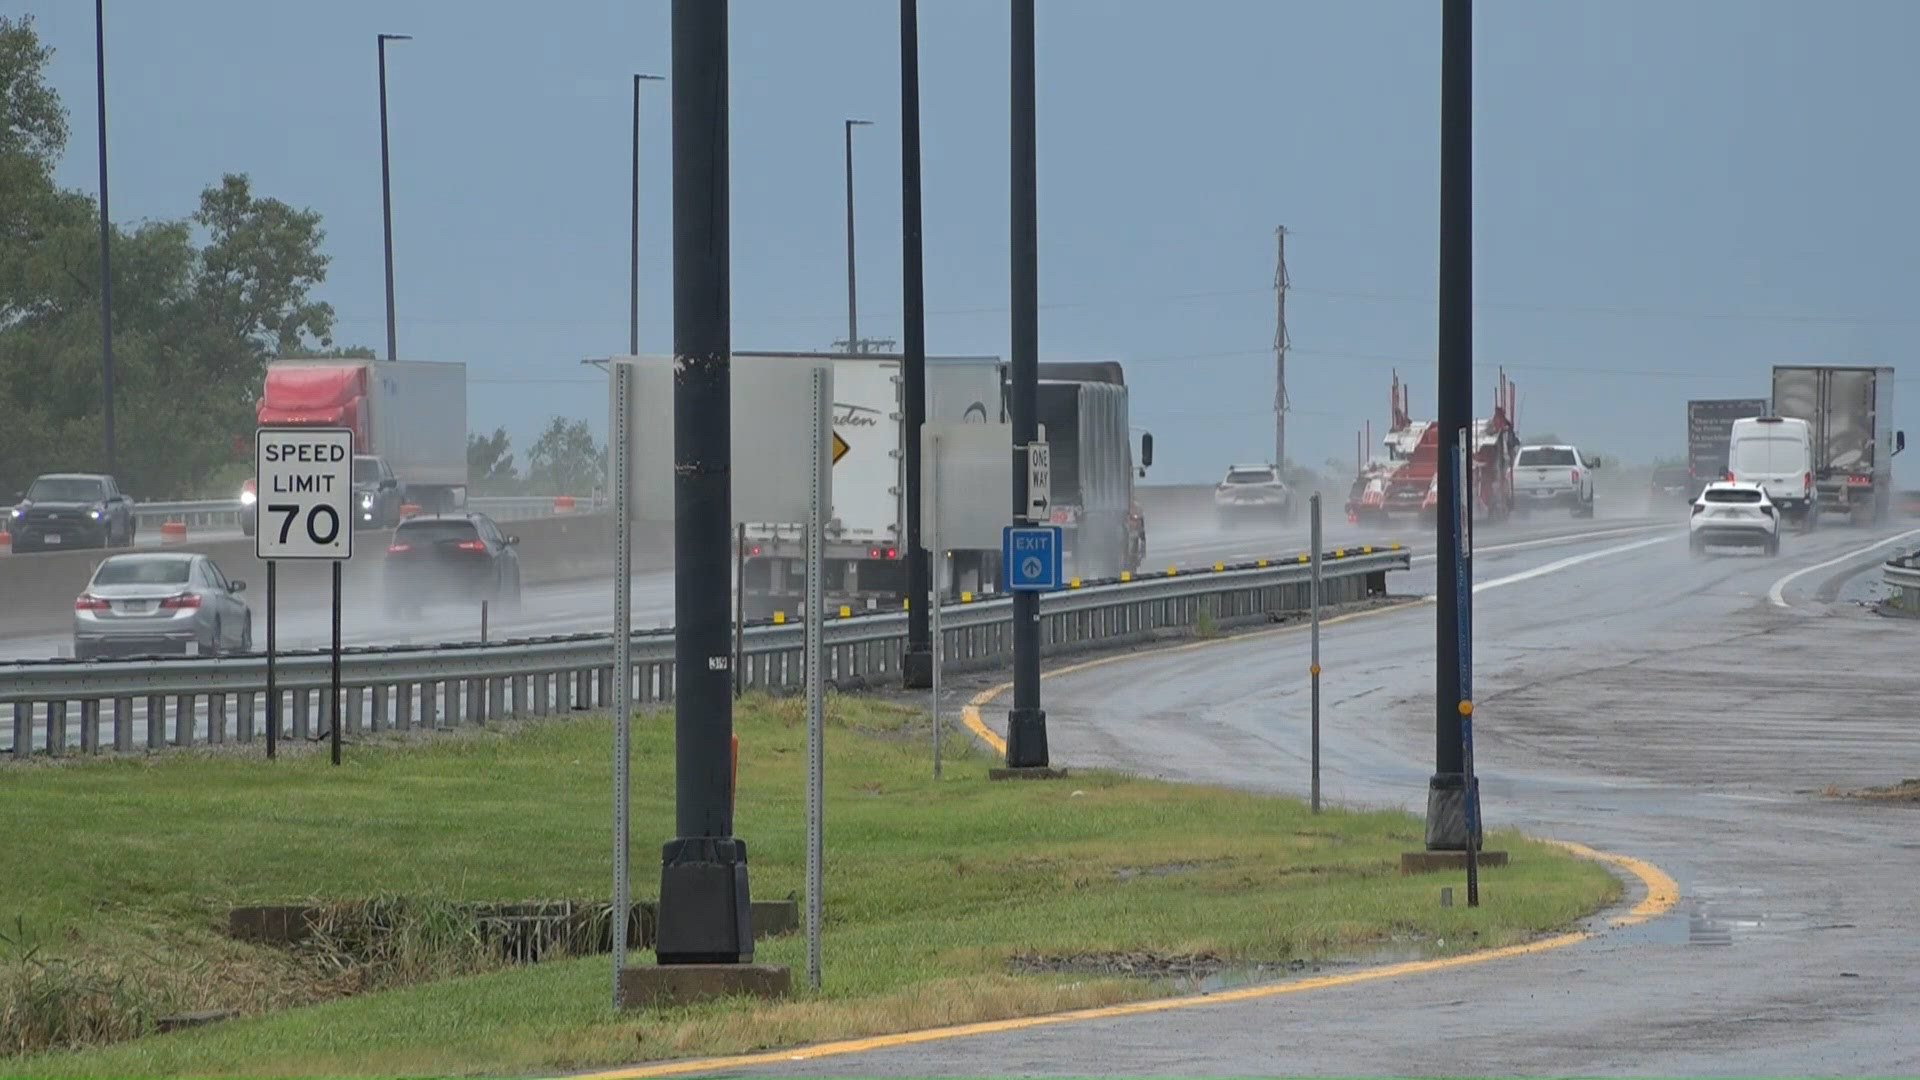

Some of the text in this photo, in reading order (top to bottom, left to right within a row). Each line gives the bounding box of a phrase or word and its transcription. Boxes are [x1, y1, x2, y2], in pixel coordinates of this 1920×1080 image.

[265, 444, 345, 462] SPEED
[1032, 449, 1048, 468] ONE
[273, 474, 336, 493] LIMIT
[1032, 471, 1049, 489] WAY
[267, 503, 340, 545] 70
[1015, 536, 1049, 550] EXIT
